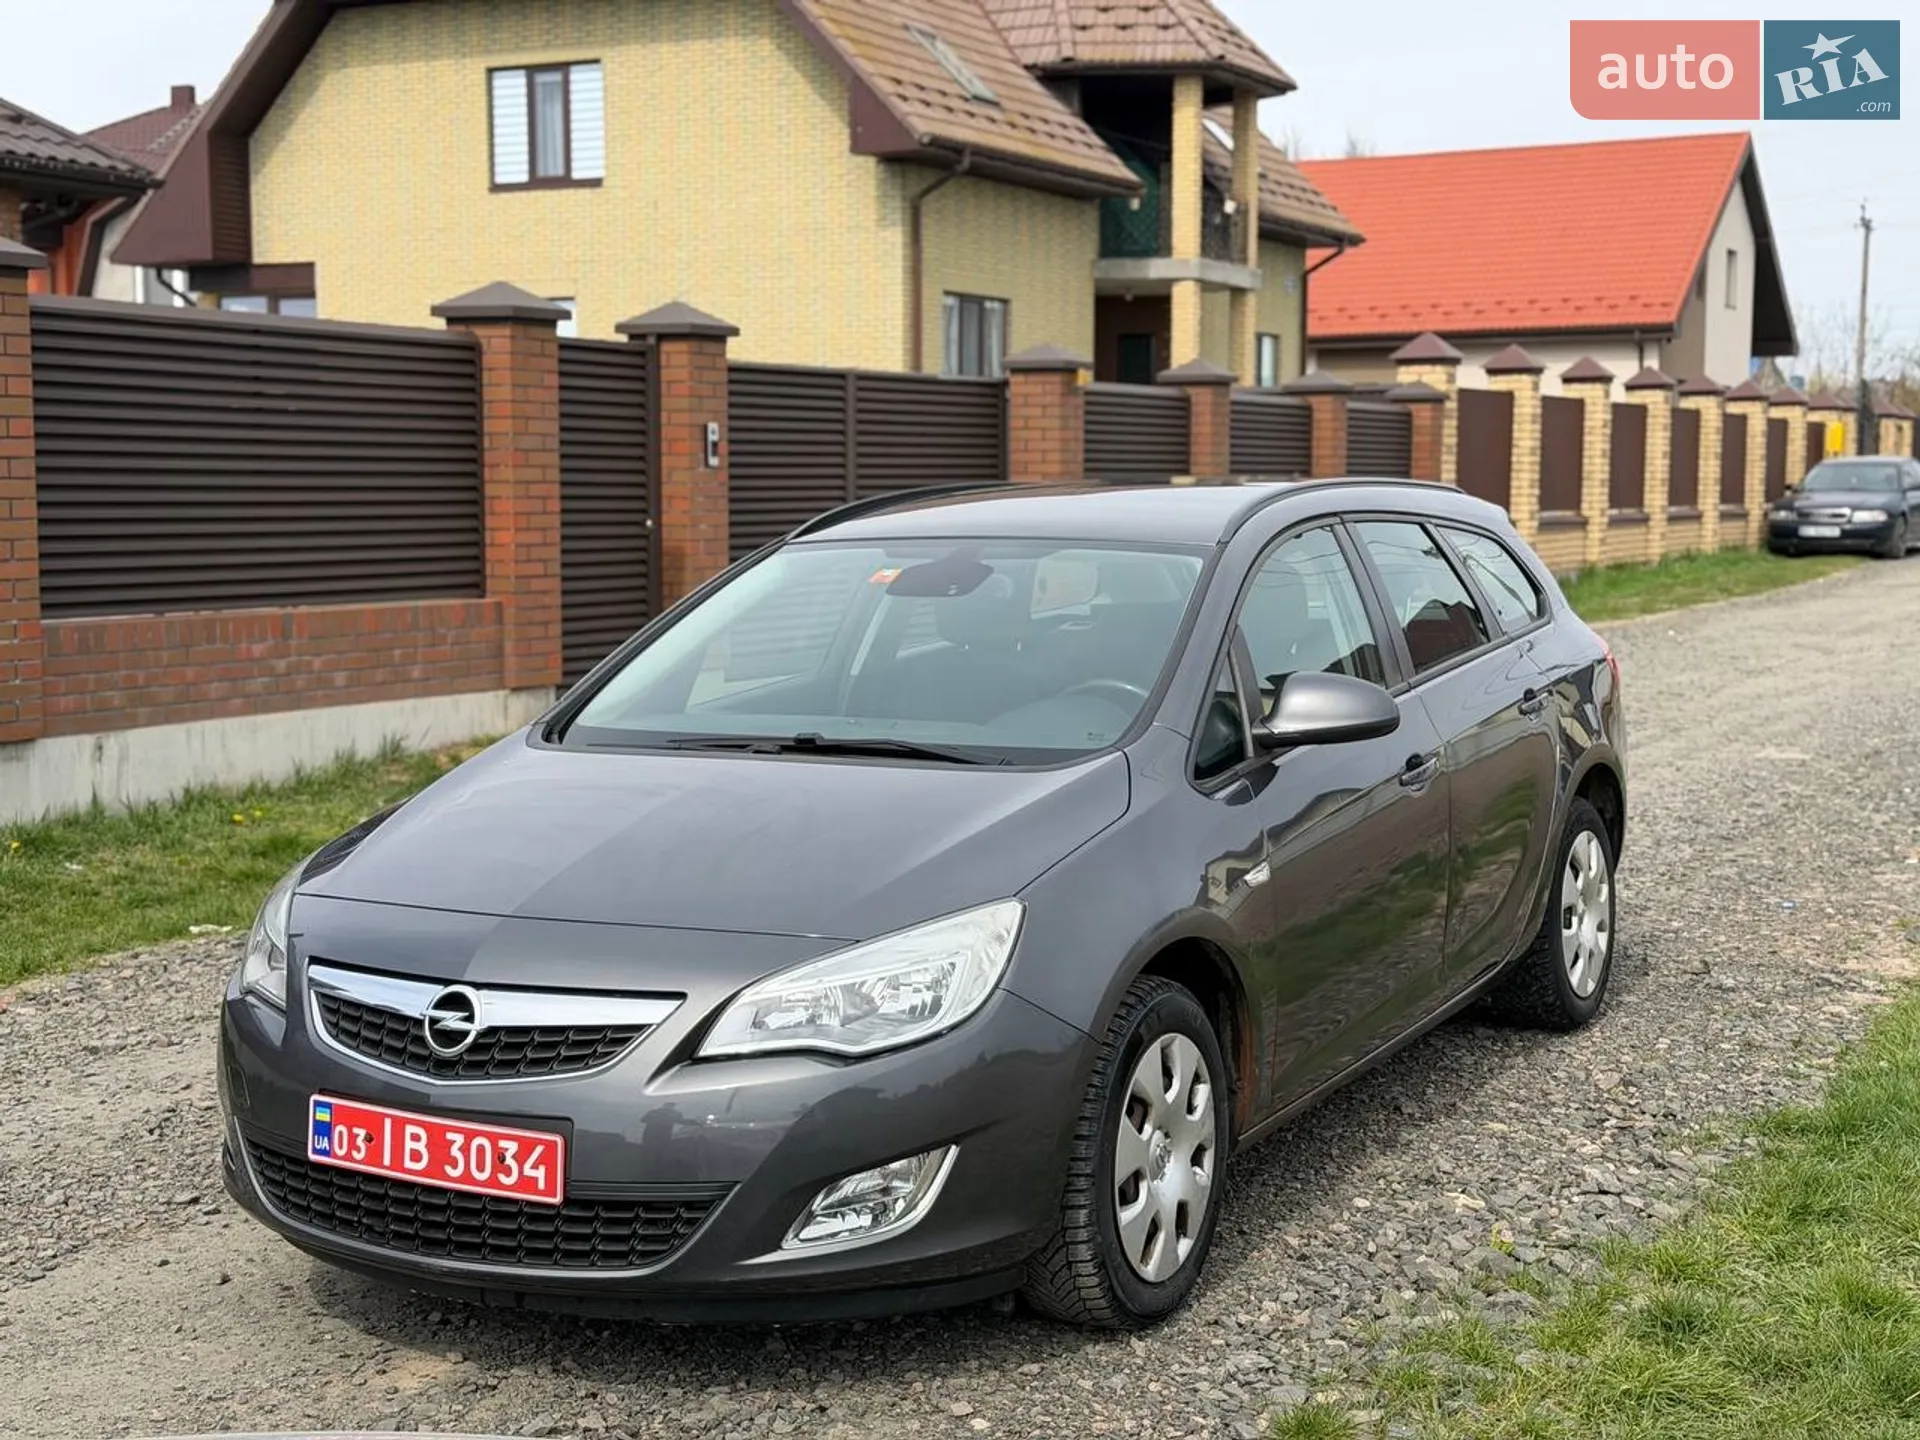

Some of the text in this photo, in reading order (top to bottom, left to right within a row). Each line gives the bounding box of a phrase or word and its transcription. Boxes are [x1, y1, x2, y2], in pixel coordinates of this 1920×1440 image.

[314, 1135, 329, 1150] UA
[334, 1125, 367, 1160] 03
[444, 1132, 546, 1190] 3034
